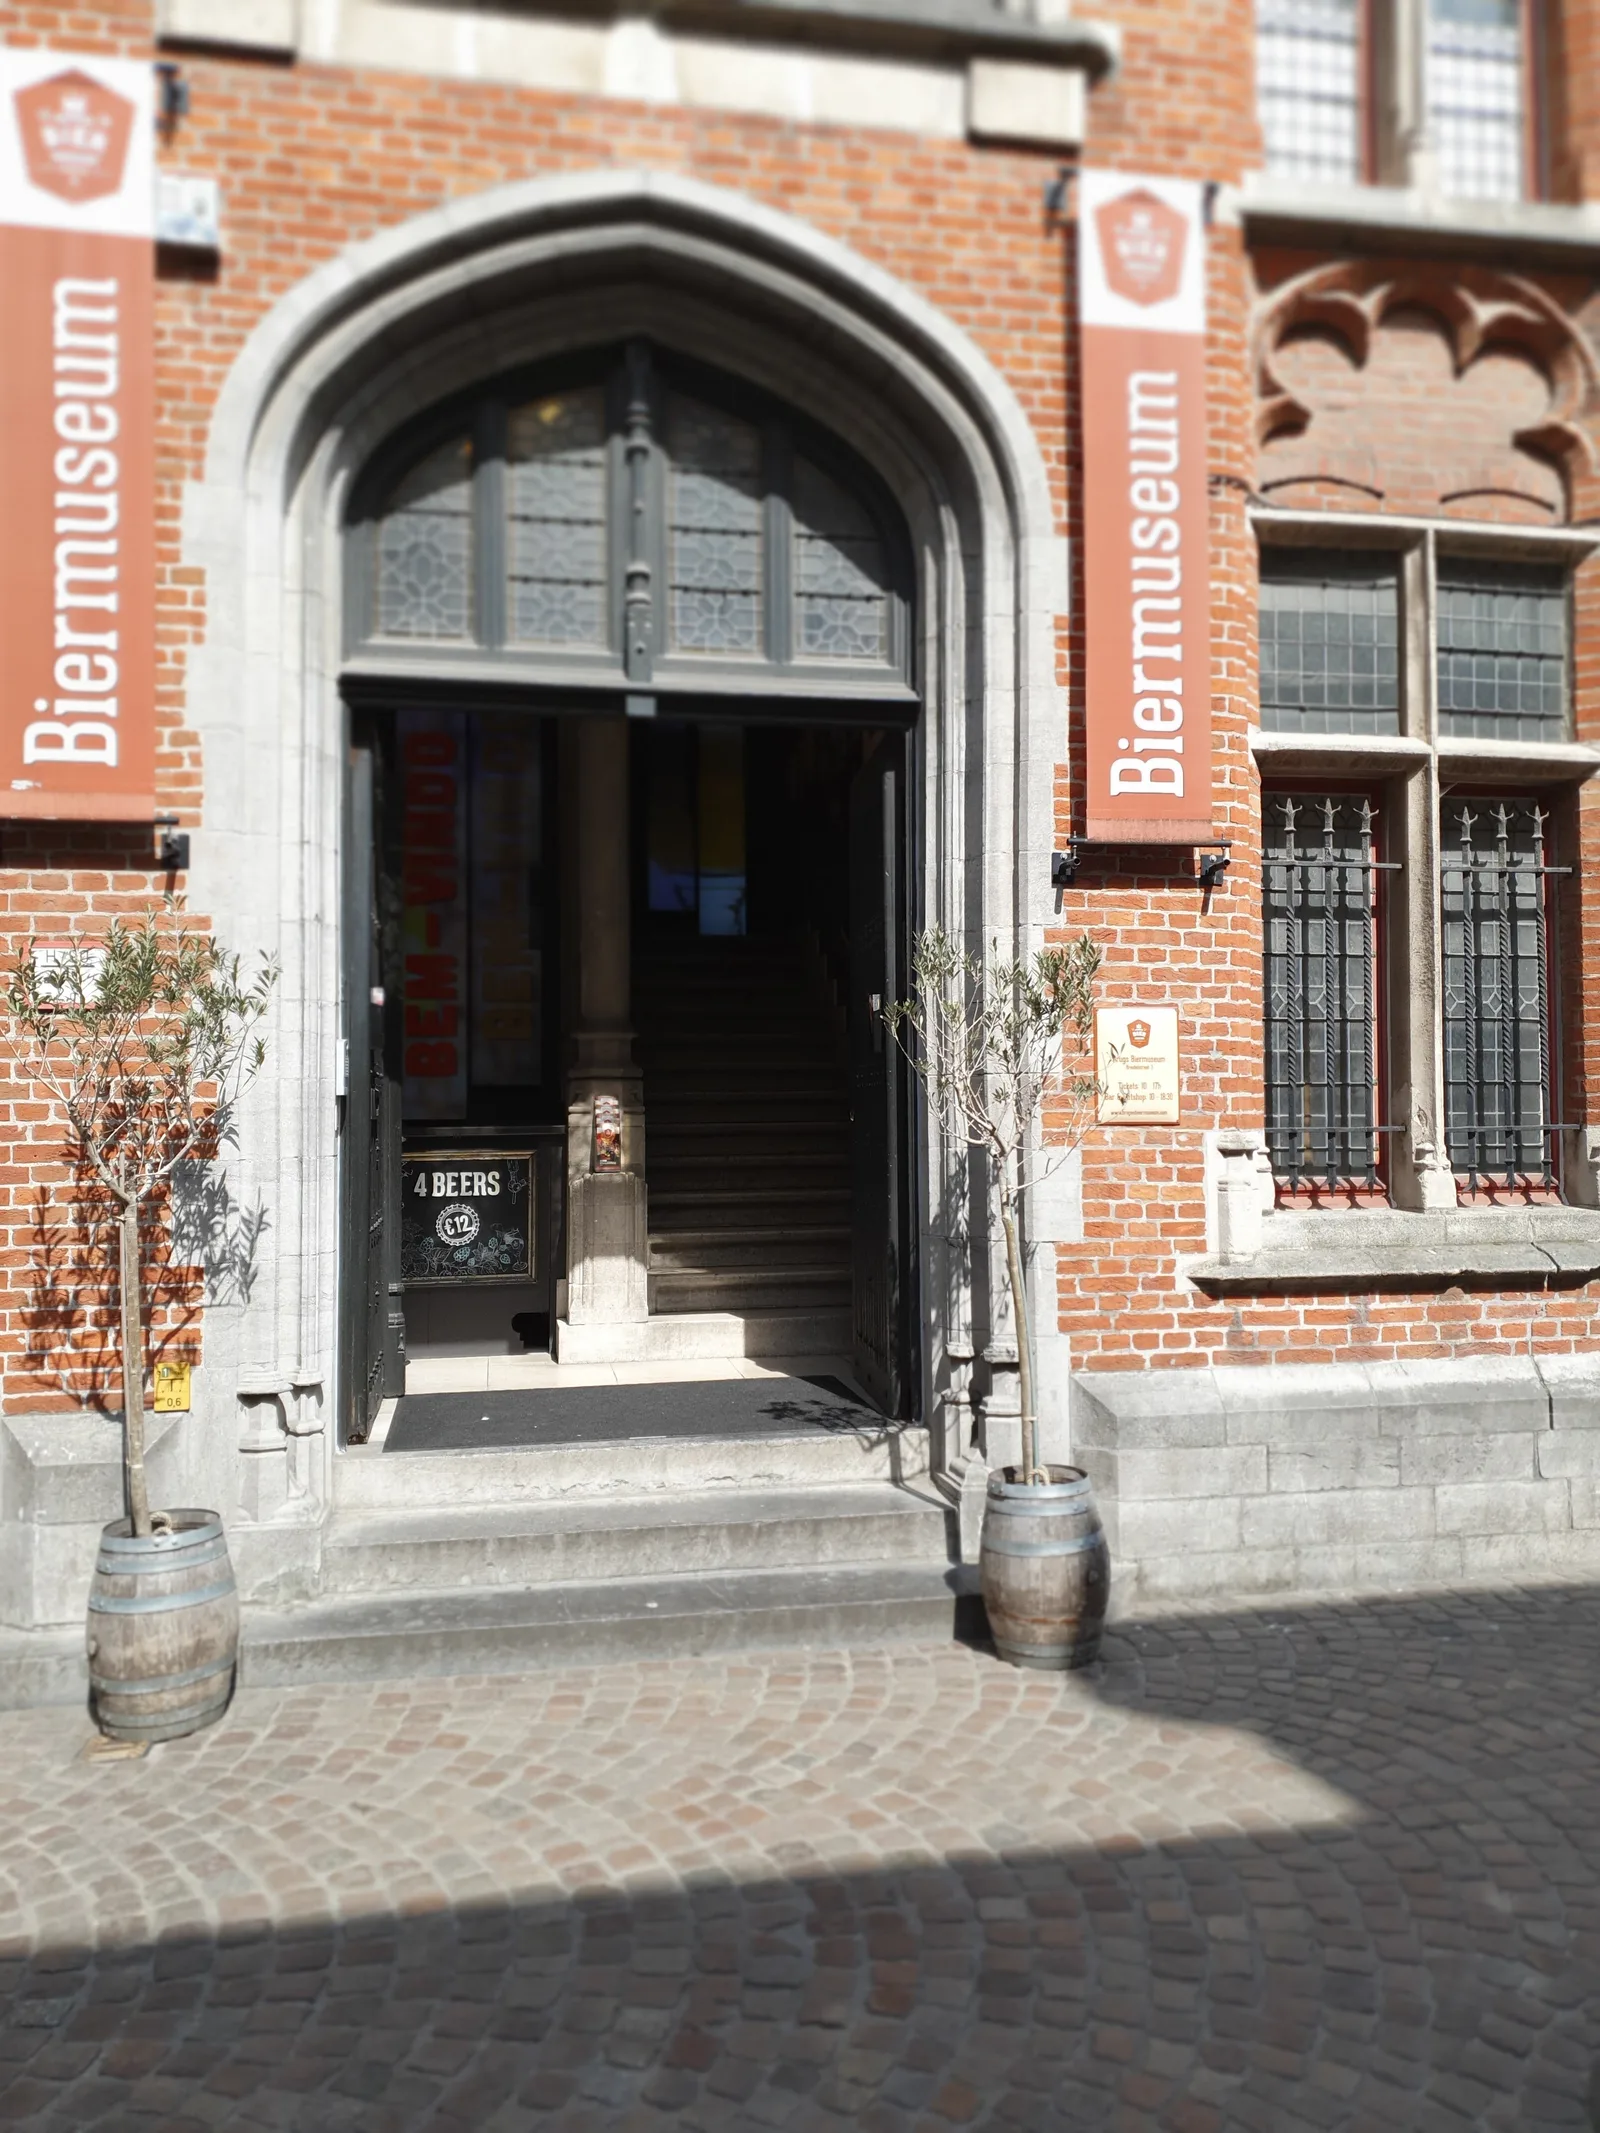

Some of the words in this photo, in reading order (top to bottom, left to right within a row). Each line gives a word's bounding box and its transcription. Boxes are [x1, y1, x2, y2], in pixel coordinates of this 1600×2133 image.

[22, 276, 120, 768] Biermuseum
[1109, 369, 1184, 798] Biermuseum
[404, 730, 458, 1078] BEM-VINDO
[1131, 1054, 1166, 1063] Biermuseum
[413, 1172, 427, 1197] 4
[431, 1170, 501, 1198] BEERS
[443, 1214, 474, 1236] €12
[166, 1397, 181, 1408] 0,6
